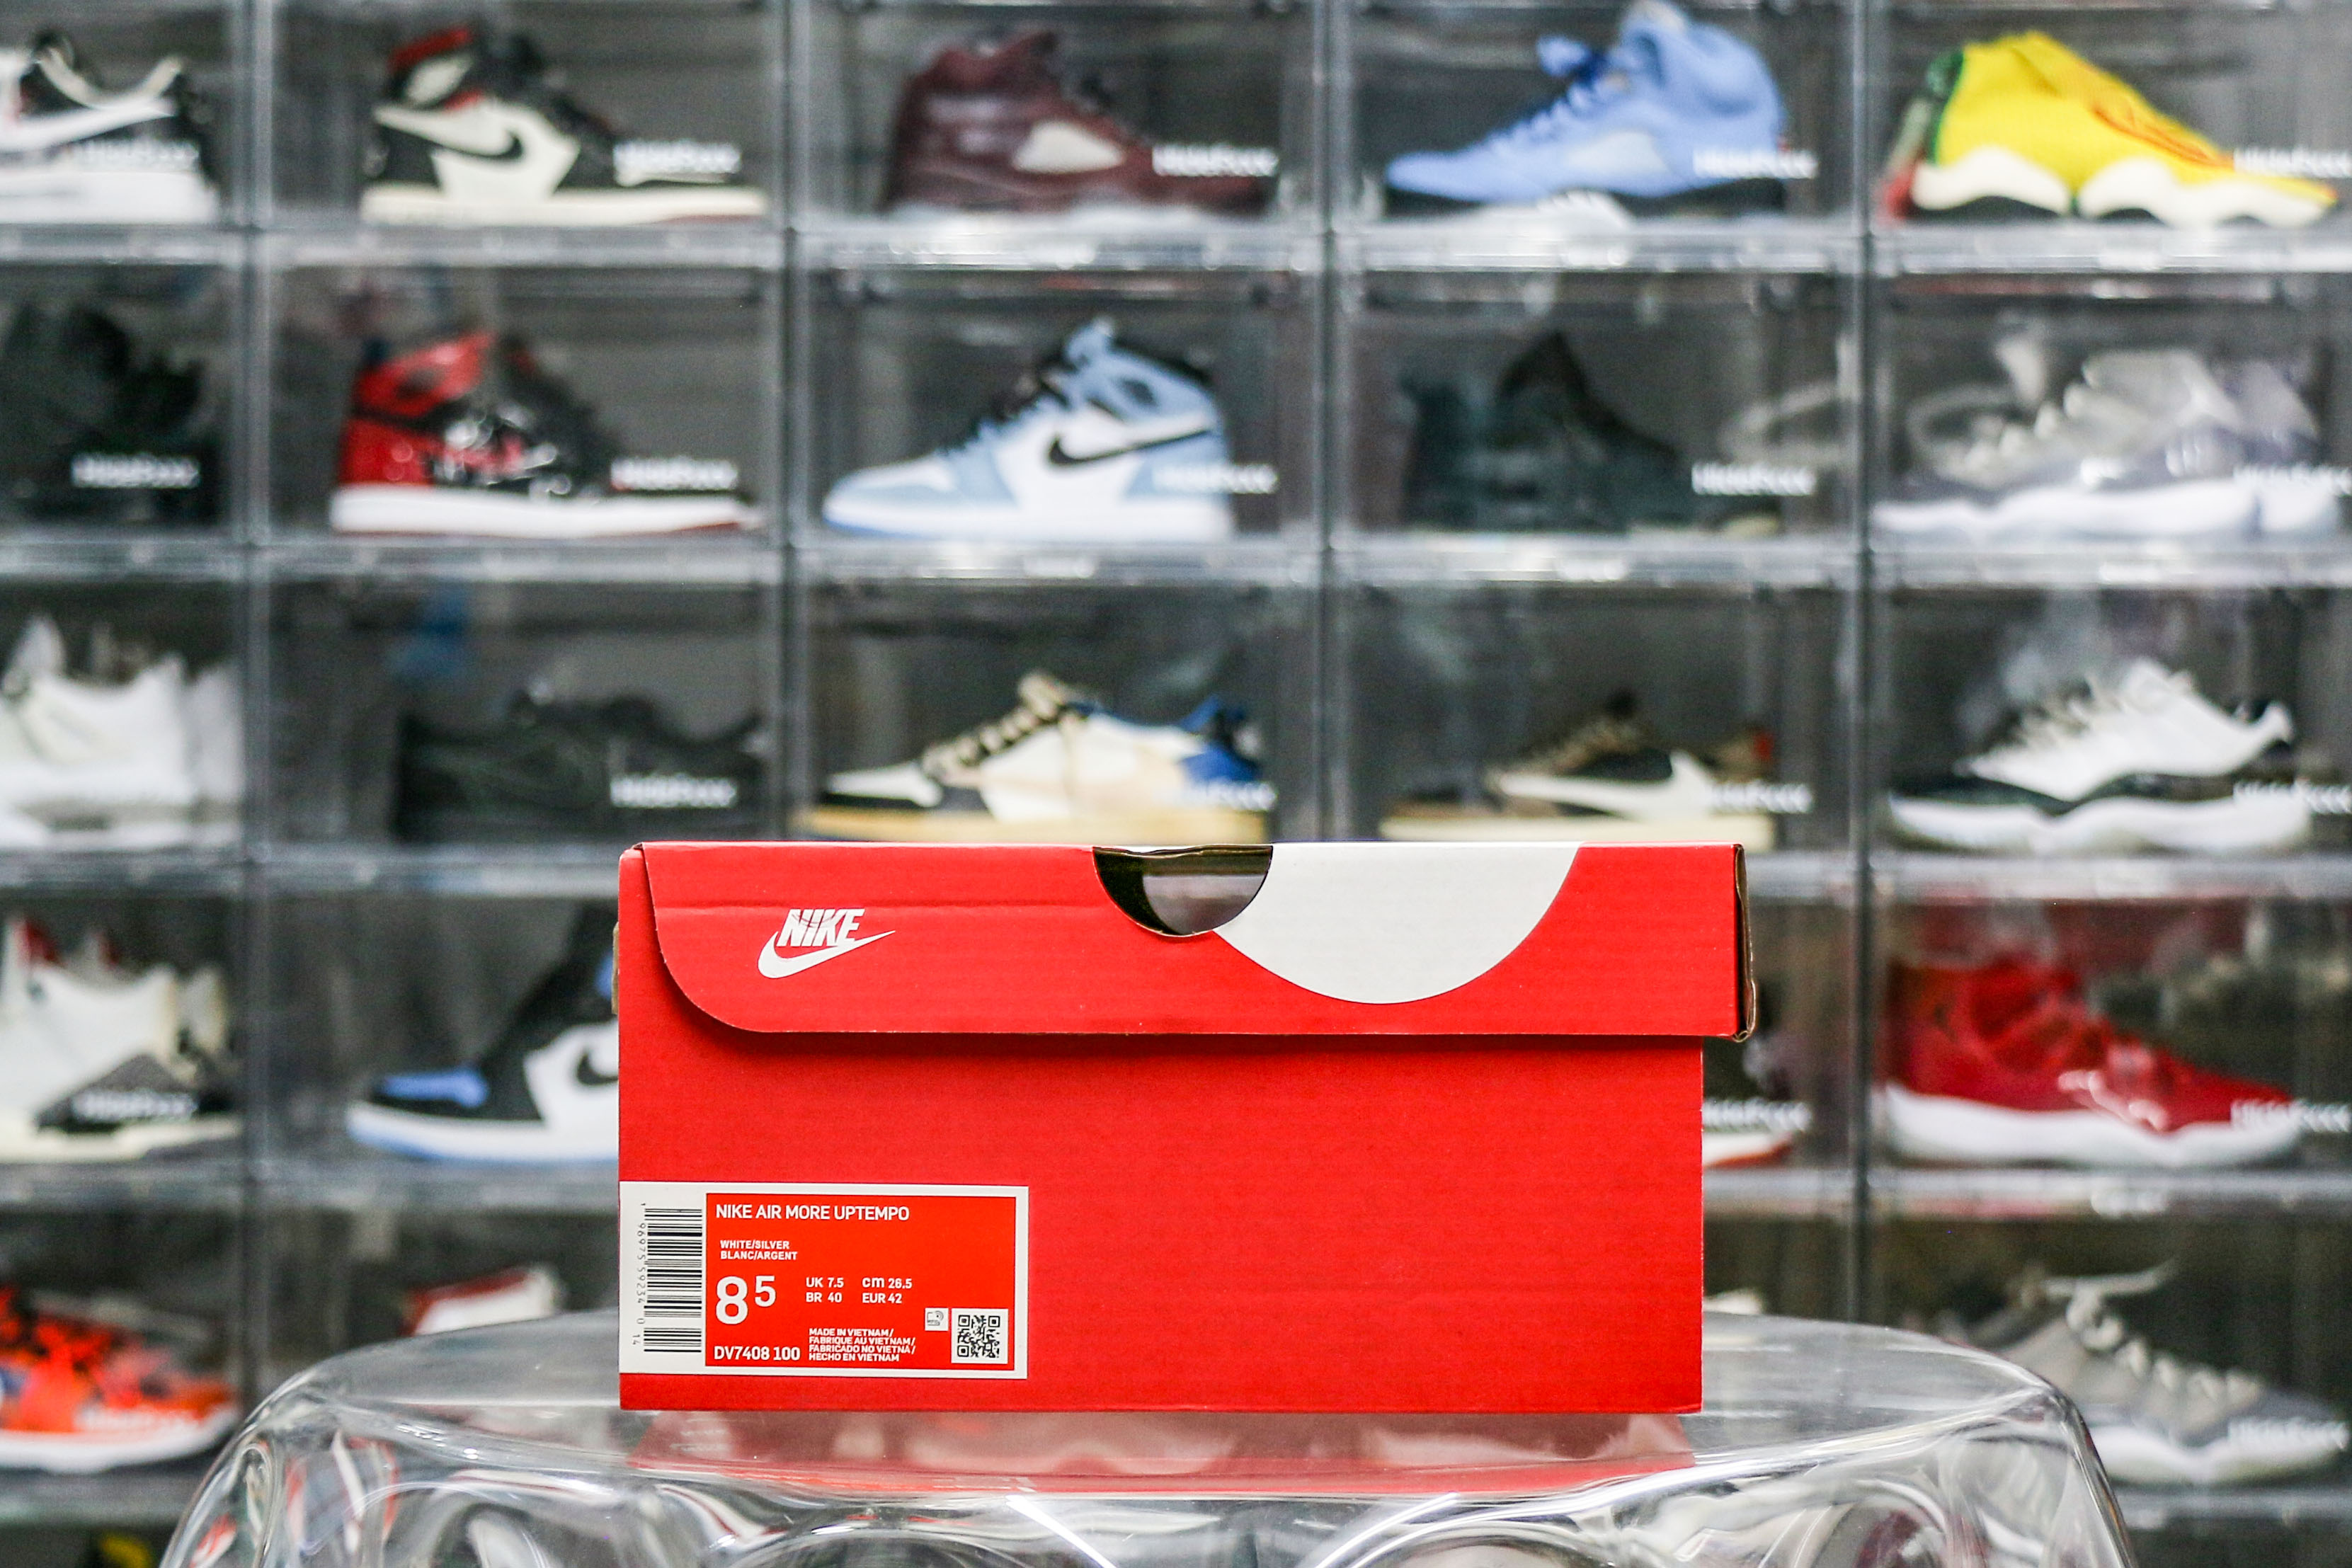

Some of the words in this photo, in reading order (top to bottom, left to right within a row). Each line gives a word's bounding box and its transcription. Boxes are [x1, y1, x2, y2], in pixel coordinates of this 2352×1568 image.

[777, 909, 865, 946] NIKE
[716, 1204, 752, 1218] NIKE
[755, 1205, 782, 1219] AIR
[786, 1206, 830, 1220] MORE
[834, 1206, 909, 1221] UPTEMPO
[720, 1240, 789, 1249] WHITE/SILVER
[721, 1251, 797, 1260] BLANC/ARGENT
[806, 1277, 823, 1288] UK
[828, 1277, 844, 1288] 7.5
[862, 1277, 884, 1288] cm
[888, 1278, 912, 1289] 26.5
[806, 1292, 822, 1303] BR
[828, 1292, 842, 1303] 40
[862, 1293, 885, 1303] EUR
[888, 1293, 902, 1304] 42
[809, 1337, 852, 1345] FABRIQUE
[714, 1346, 770, 1361] DV7408
[773, 1347, 800, 1361] 100
[809, 1344, 860, 1353] FABRICADO
